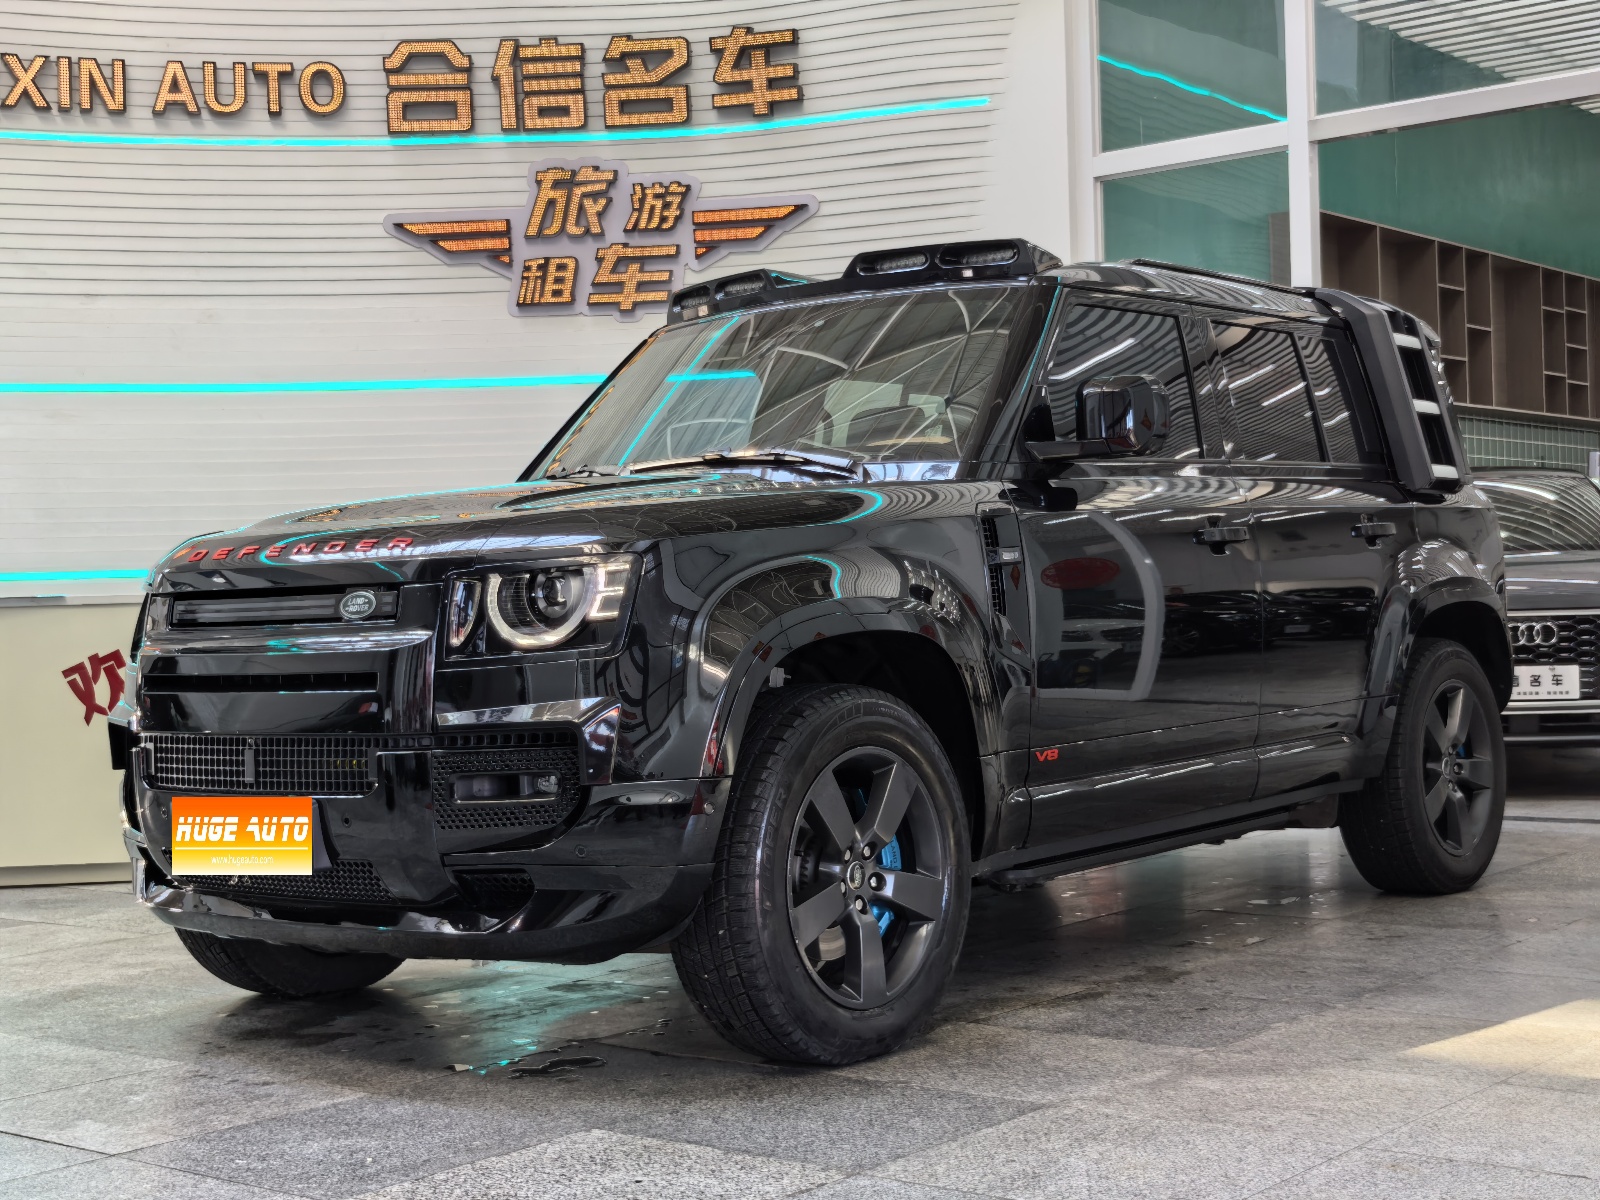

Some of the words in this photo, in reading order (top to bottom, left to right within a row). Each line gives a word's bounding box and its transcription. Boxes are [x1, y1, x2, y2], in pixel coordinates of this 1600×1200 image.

[0, 53, 126, 112] XIN
[152, 60, 347, 116] AUTO
[383, 26, 803, 135] 合信名车
[524, 165, 691, 239] 旅游
[517, 242, 680, 312] 租车
[186, 537, 414, 562] DEFENDER
[61, 648, 126, 727] 欢
[1035, 749, 1059, 762] V8
